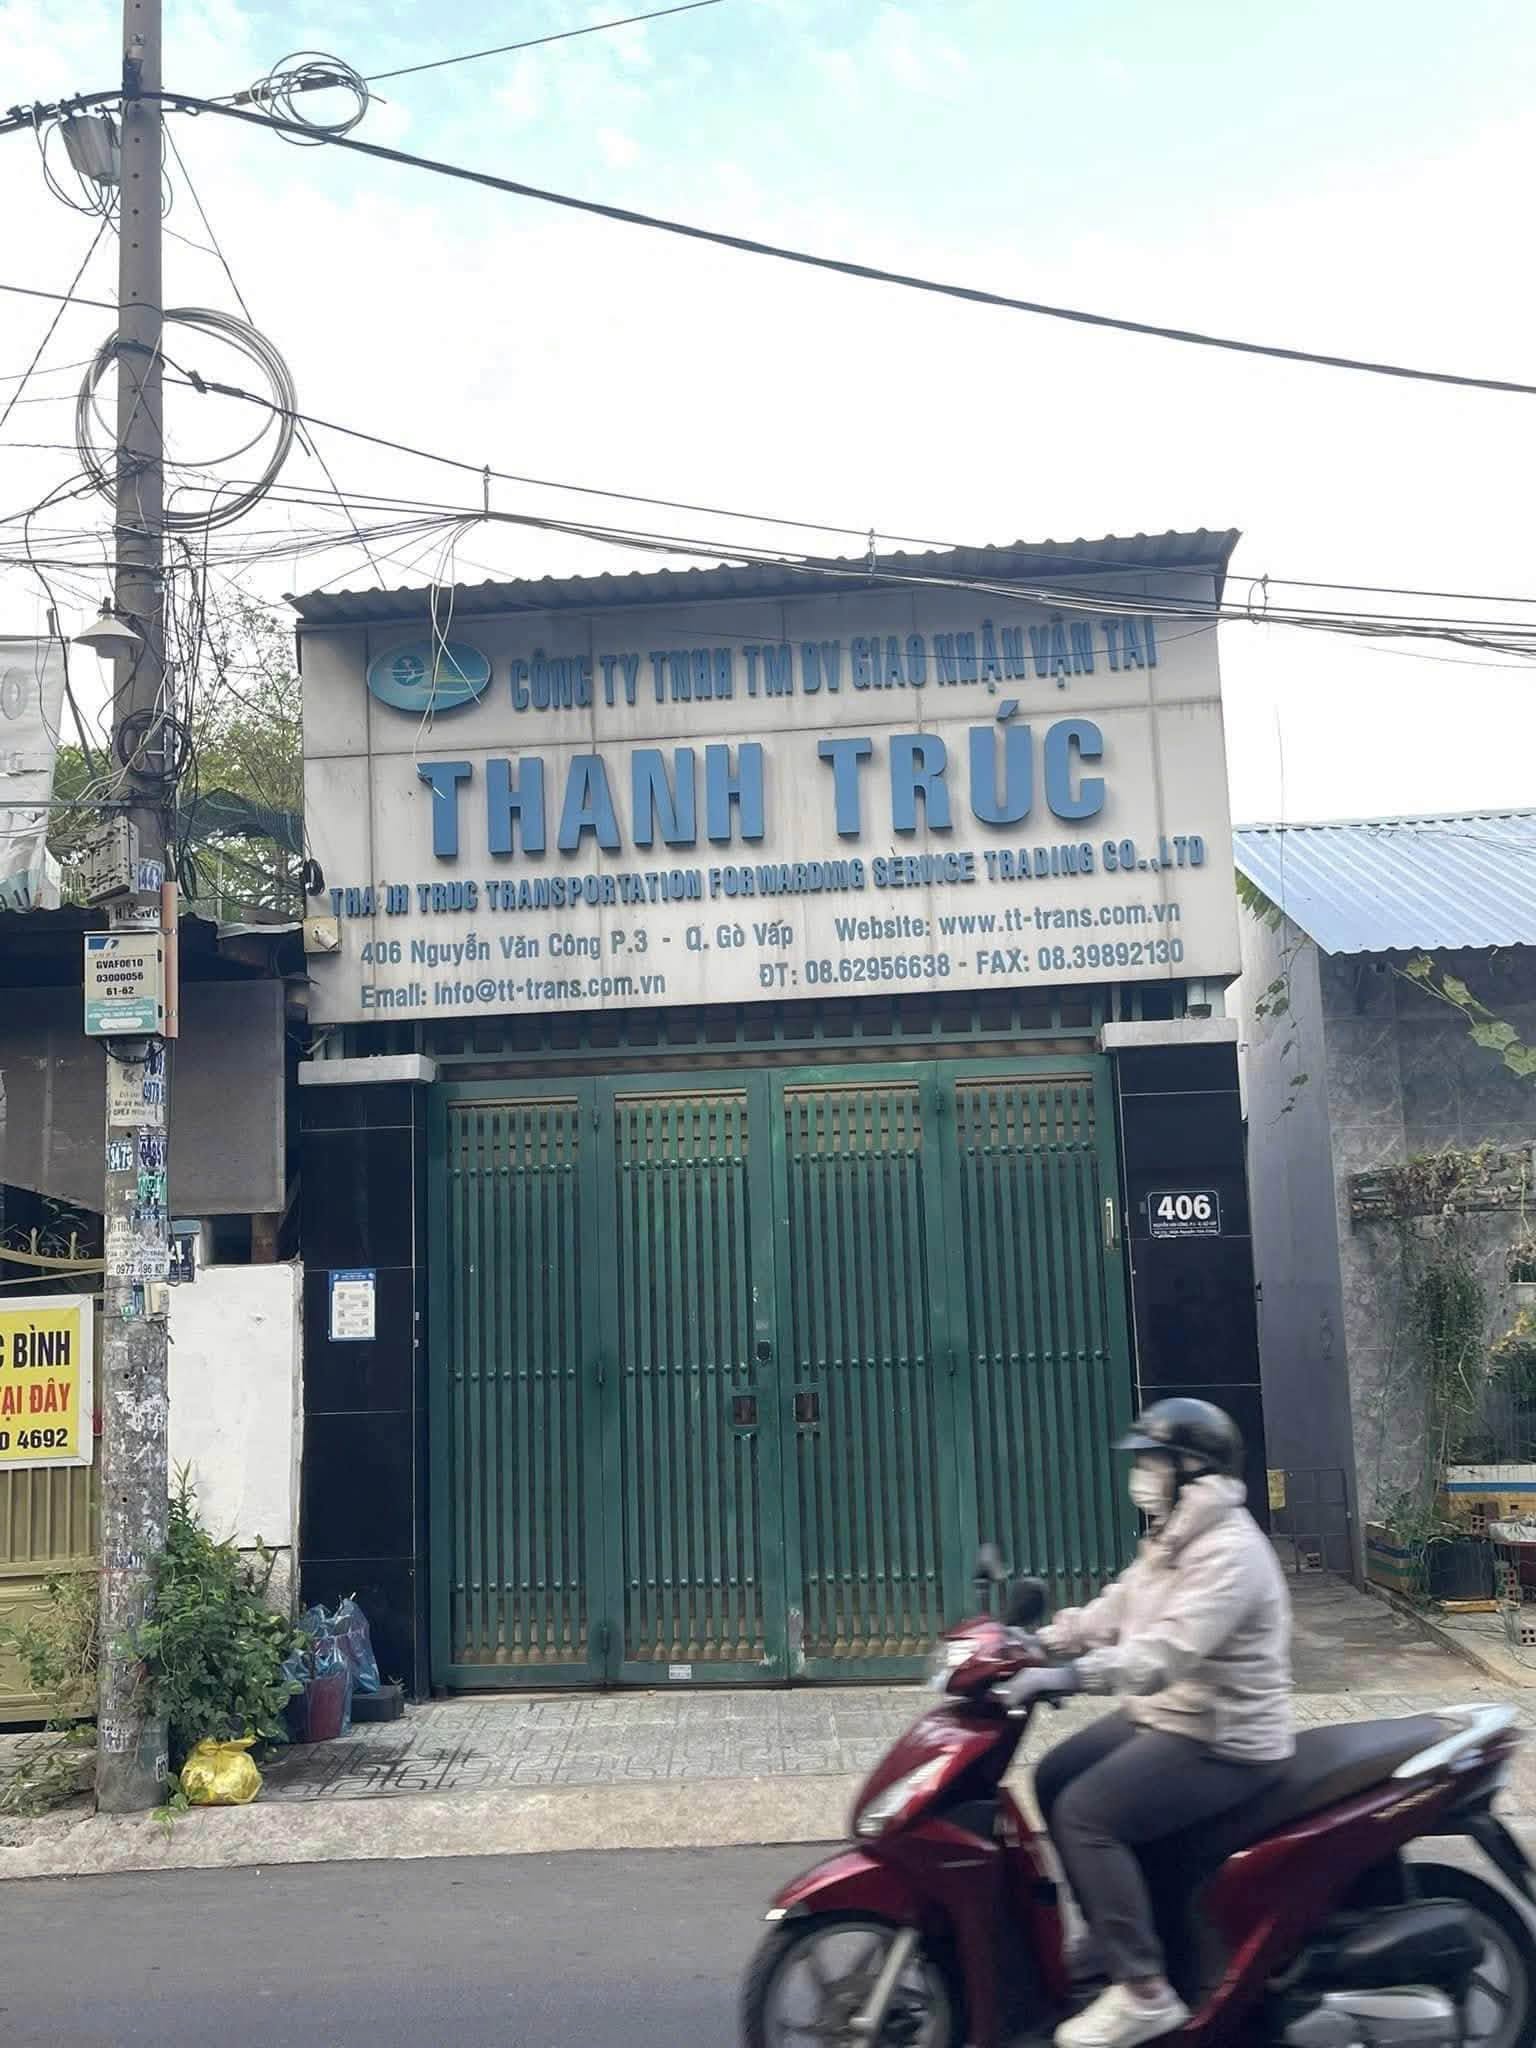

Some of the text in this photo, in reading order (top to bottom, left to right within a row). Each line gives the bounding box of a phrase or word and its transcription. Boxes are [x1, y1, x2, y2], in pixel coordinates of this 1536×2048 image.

[511, 648, 592, 711] CÔNG
[600, 653, 639, 705] TY
[649, 648, 732, 702] TNHH
[743, 644, 793, 697] TM
[802, 640, 841, 694] DV
[852, 633, 927, 689] GIAO
[934, 619, 1026, 694] NHẬN
[417, 699, 1106, 858] THANH TRÚC
[417, 879, 479, 914] TRUC
[485, 868, 702, 912] TRANSPORTATION
[709, 854, 866, 899] FORWARDING
[872, 851, 976, 888] SERVICE
[983, 841, 1095, 881] TRADING
[361, 940, 402, 965] 406
[411, 932, 491, 968] Nguyễn
[500, 935, 540, 960] Văn
[549, 928, 601, 961] Công
[611, 930, 649, 954] P.3
[686, 927, 710, 951] Q.
[717, 922, 745, 949] Gò
[753, 919, 794, 950] Vấp
[834, 902, 1181, 943] Website: www.tt-trans.com.vn
[759, 963, 798, 987] ĐT:
[805, 953, 951, 984] 08.62956638
[977, 949, 1031, 976] FAX:
[1037, 938, 1185, 972] 08.39892130
[361, 984, 427, 1009] Email:
[1157, 1194, 1212, 1220] 406
[13, 1324, 71, 1369] BÌNH
[0, 1377, 71, 1422] ẠI ĐÂY
[17, 1428, 68, 1449] 4692
